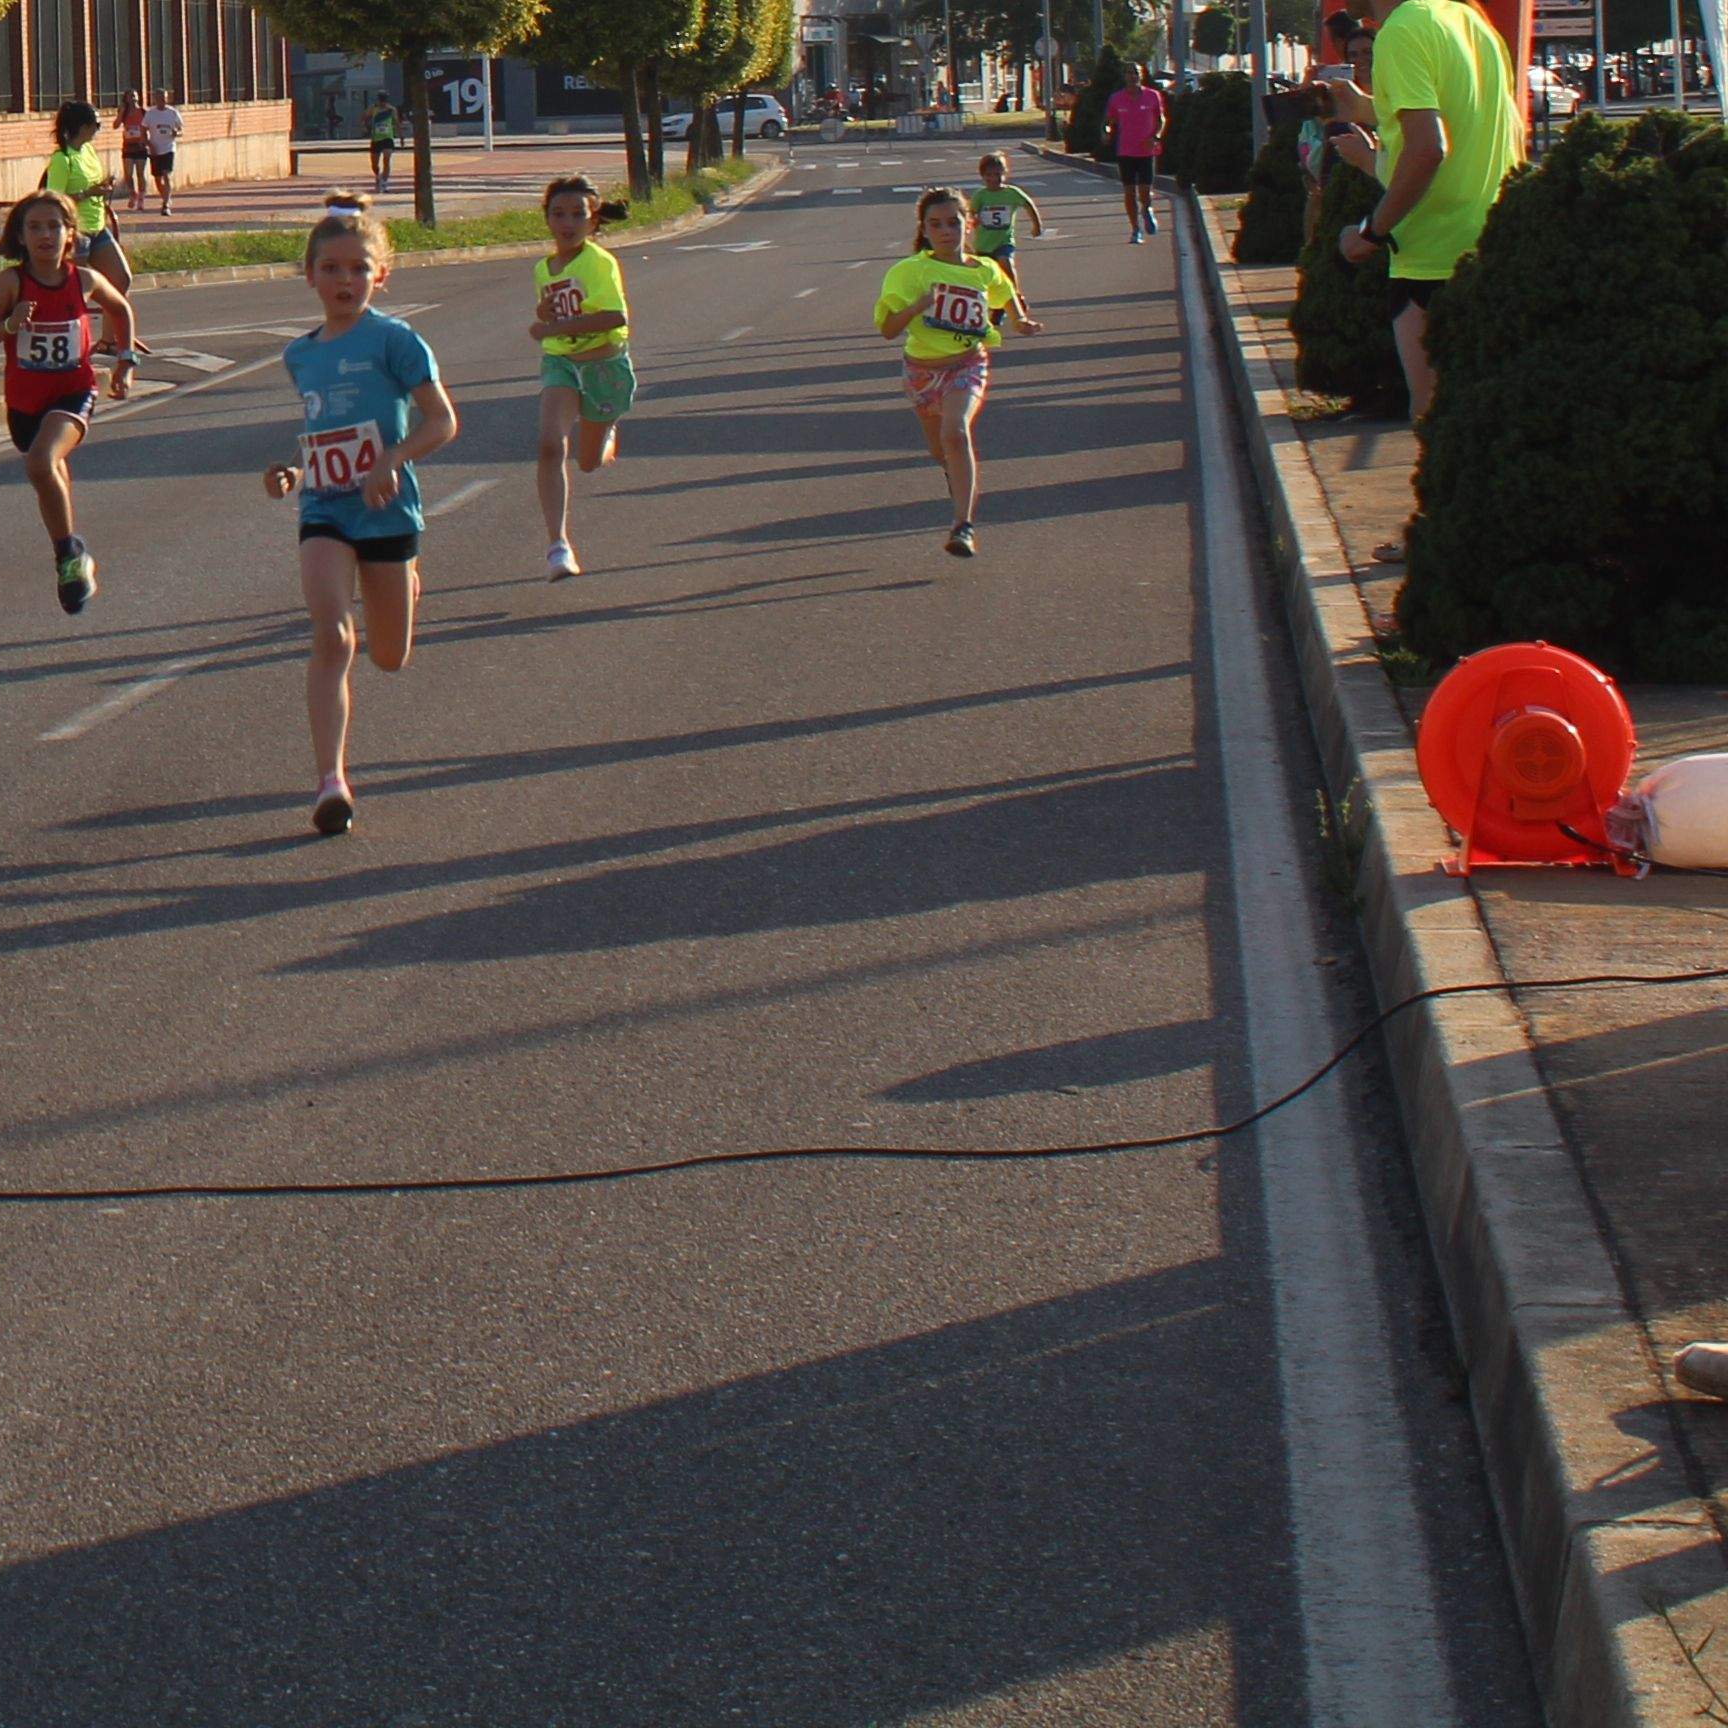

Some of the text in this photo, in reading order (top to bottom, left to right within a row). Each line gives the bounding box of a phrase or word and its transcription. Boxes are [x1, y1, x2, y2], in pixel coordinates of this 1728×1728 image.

[442, 78, 484, 115] 19
[991, 212, 1001, 225] 5
[933, 294, 983, 329] 103
[30, 336, 70, 363] 58
[308, 438, 376, 488] 104
